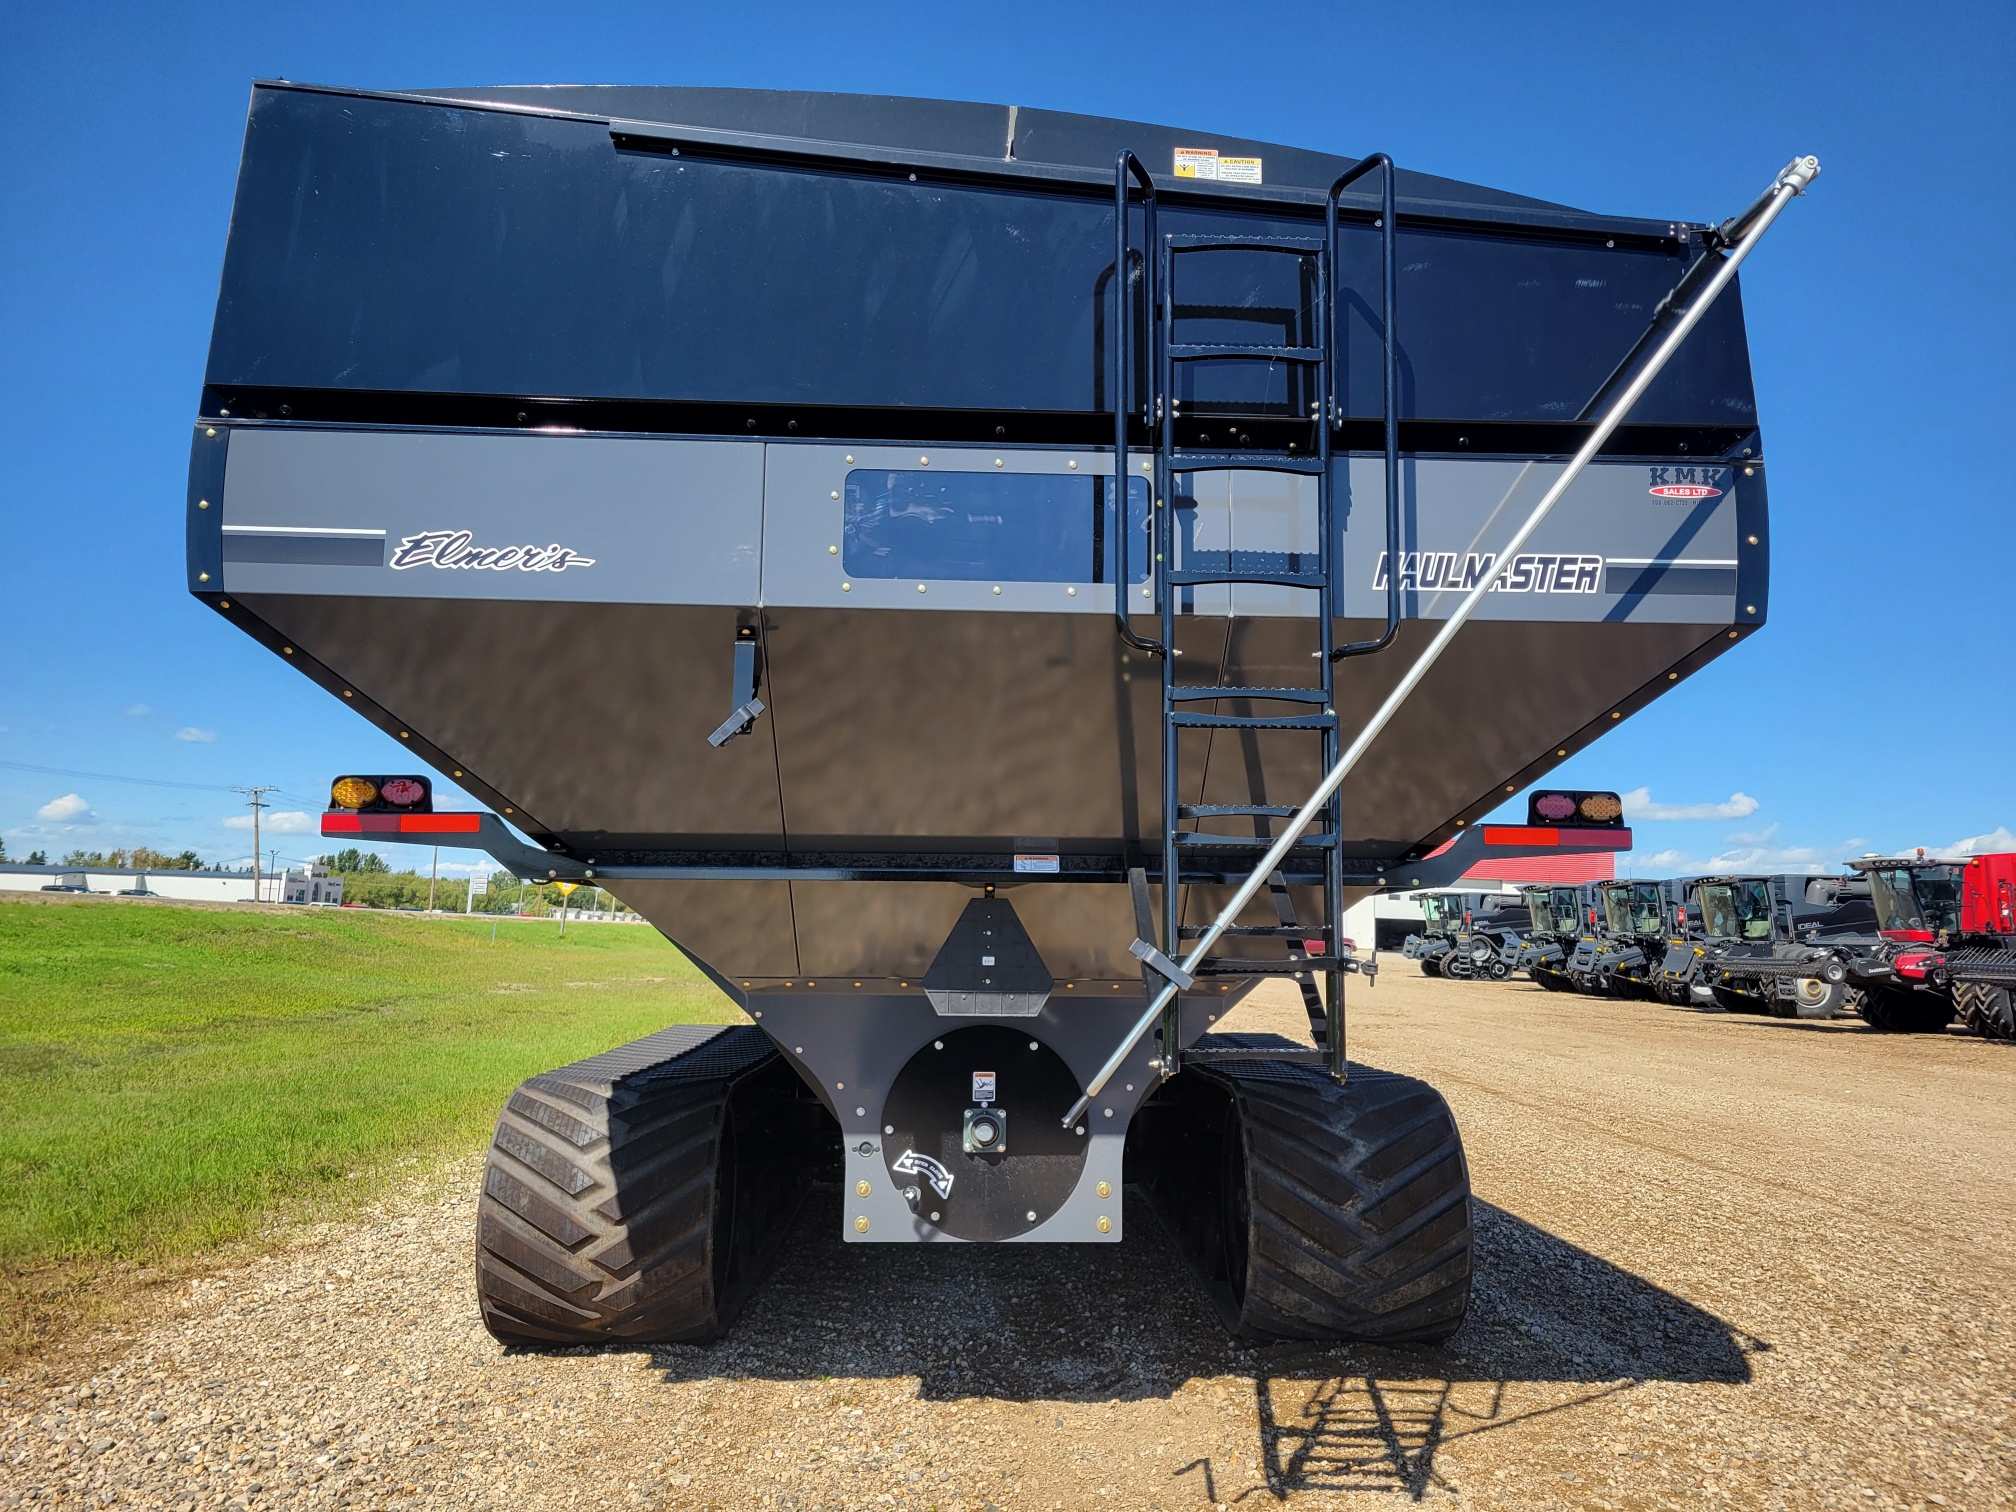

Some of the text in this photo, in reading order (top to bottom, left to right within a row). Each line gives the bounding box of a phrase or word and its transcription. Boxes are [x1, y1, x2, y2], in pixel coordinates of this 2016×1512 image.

[390, 530, 597, 573] Elmer's
[1797, 920, 1824, 930] IDEAL
[914, 1159, 944, 1180] OPEN CLOSE
